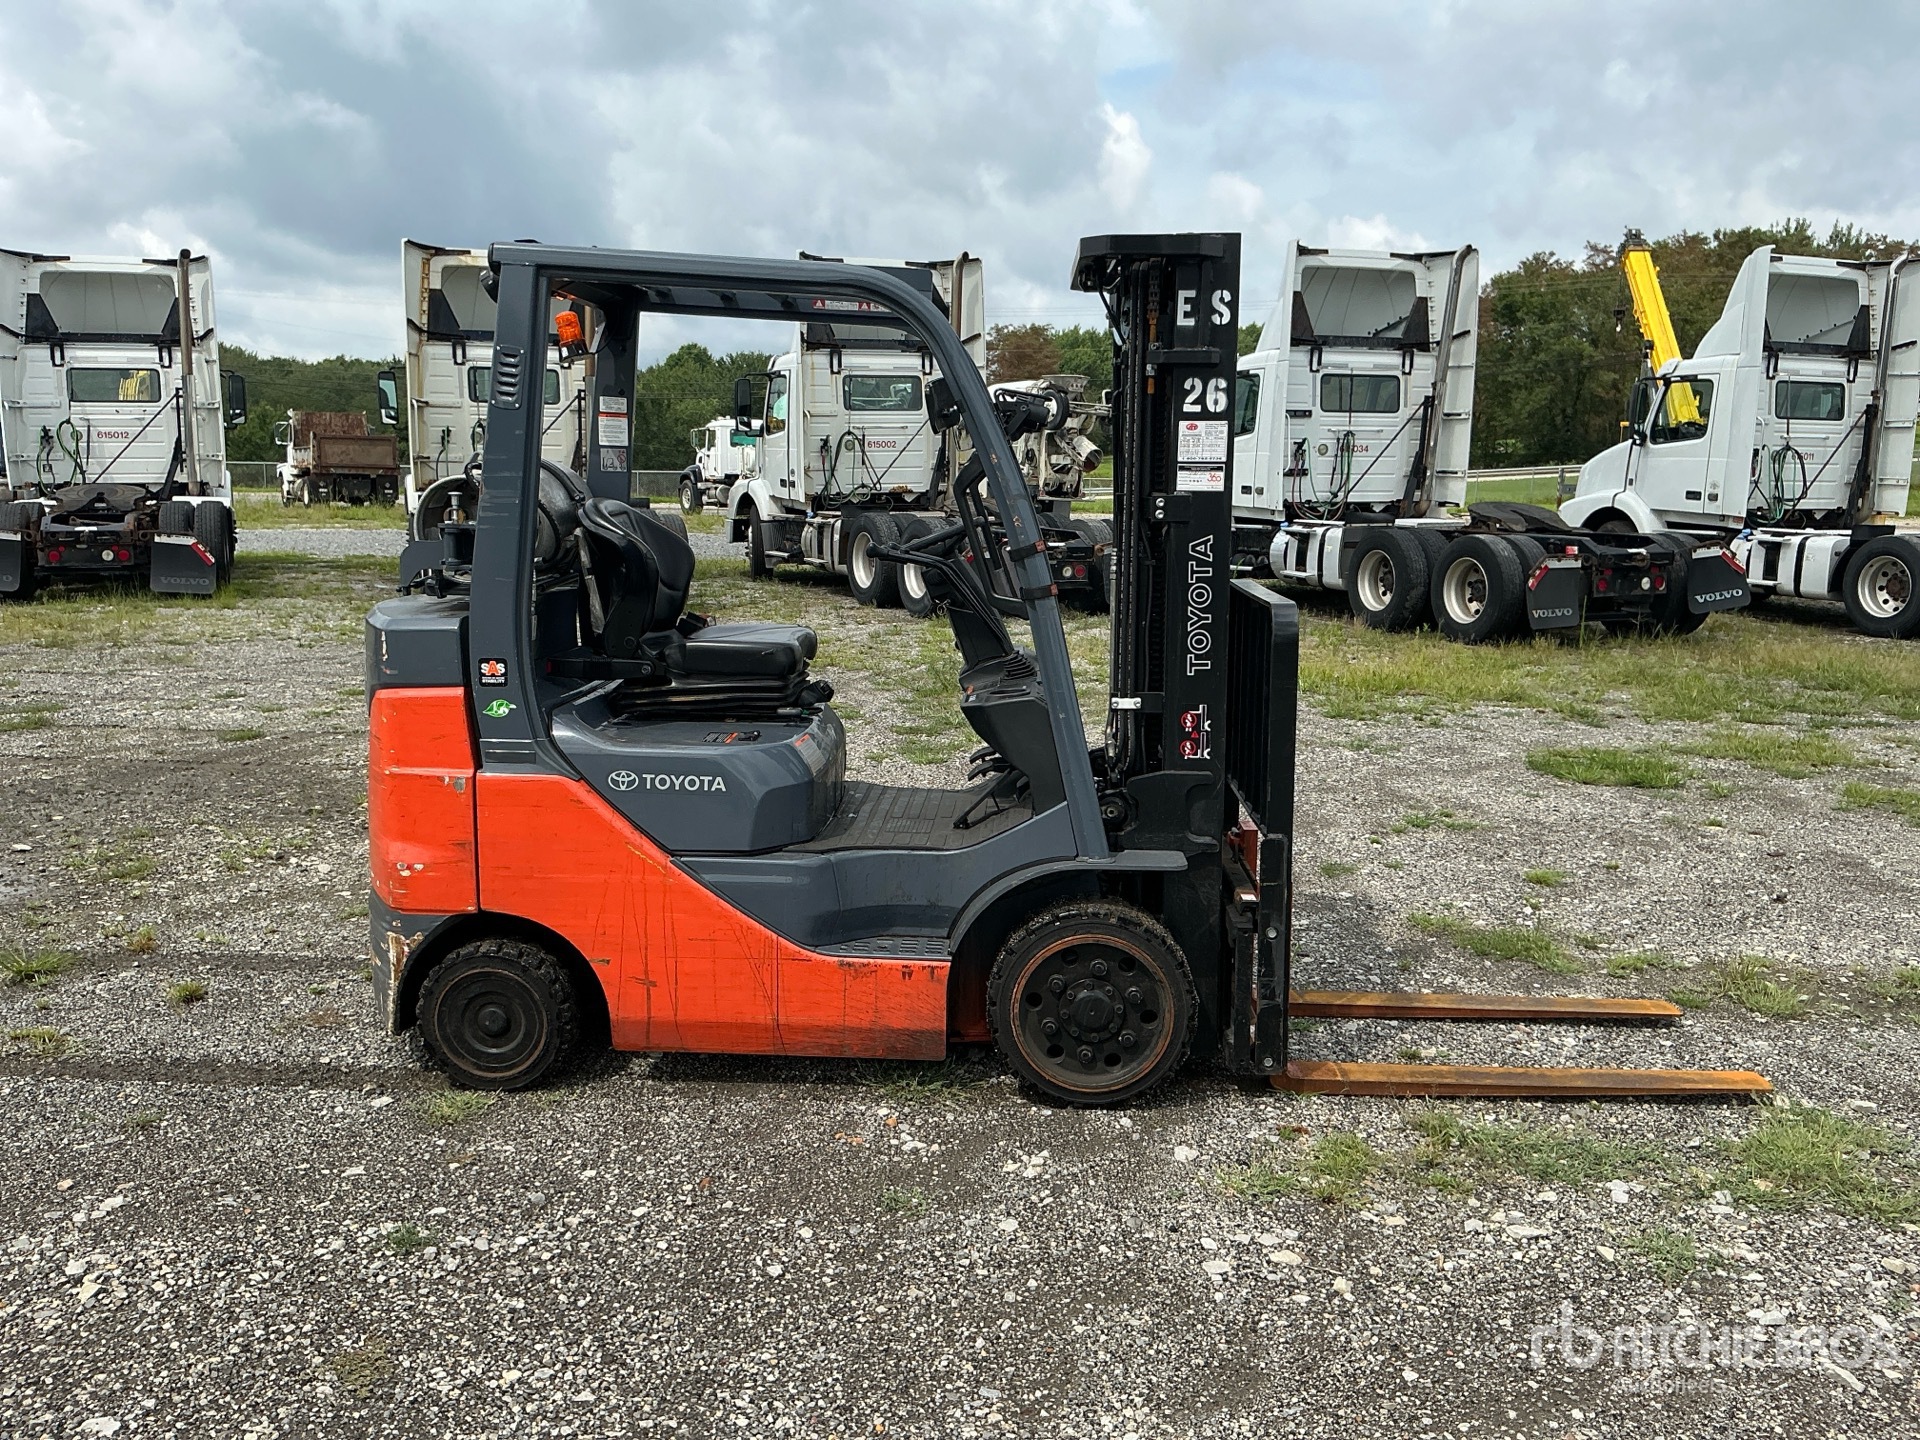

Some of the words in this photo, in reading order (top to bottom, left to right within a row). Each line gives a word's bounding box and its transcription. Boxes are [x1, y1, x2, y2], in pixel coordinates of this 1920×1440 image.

[1177, 290, 1196, 325] E
[1211, 290, 1231, 325] S
[1182, 377, 1228, 412] 26
[97, 431, 129, 439] 615012
[867, 440, 897, 448] 615002
[159, 576, 210, 586] VOLVO
[1694, 588, 1743, 604] VOLVO
[1187, 534, 1213, 676] TOYOTA
[1532, 607, 1573, 619] VOLVO
[480, 660, 506, 676] SAS
[642, 773, 727, 792] TOYOTA
